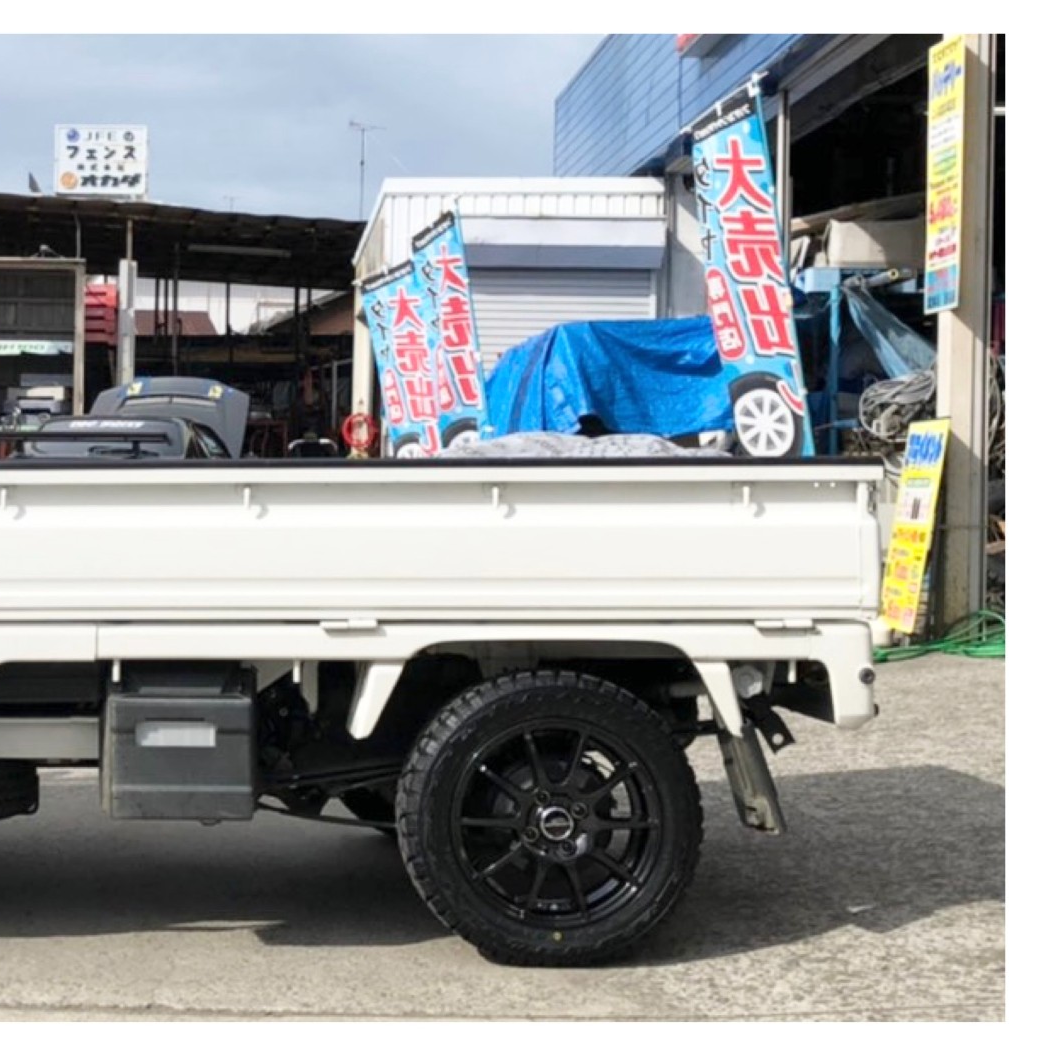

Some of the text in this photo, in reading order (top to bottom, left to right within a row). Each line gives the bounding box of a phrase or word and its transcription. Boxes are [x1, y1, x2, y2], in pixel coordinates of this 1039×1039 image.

[66, 145, 137, 160] フェンス
[81, 173, 142, 187] オカダ
[390, 287, 439, 456] 大売出し
